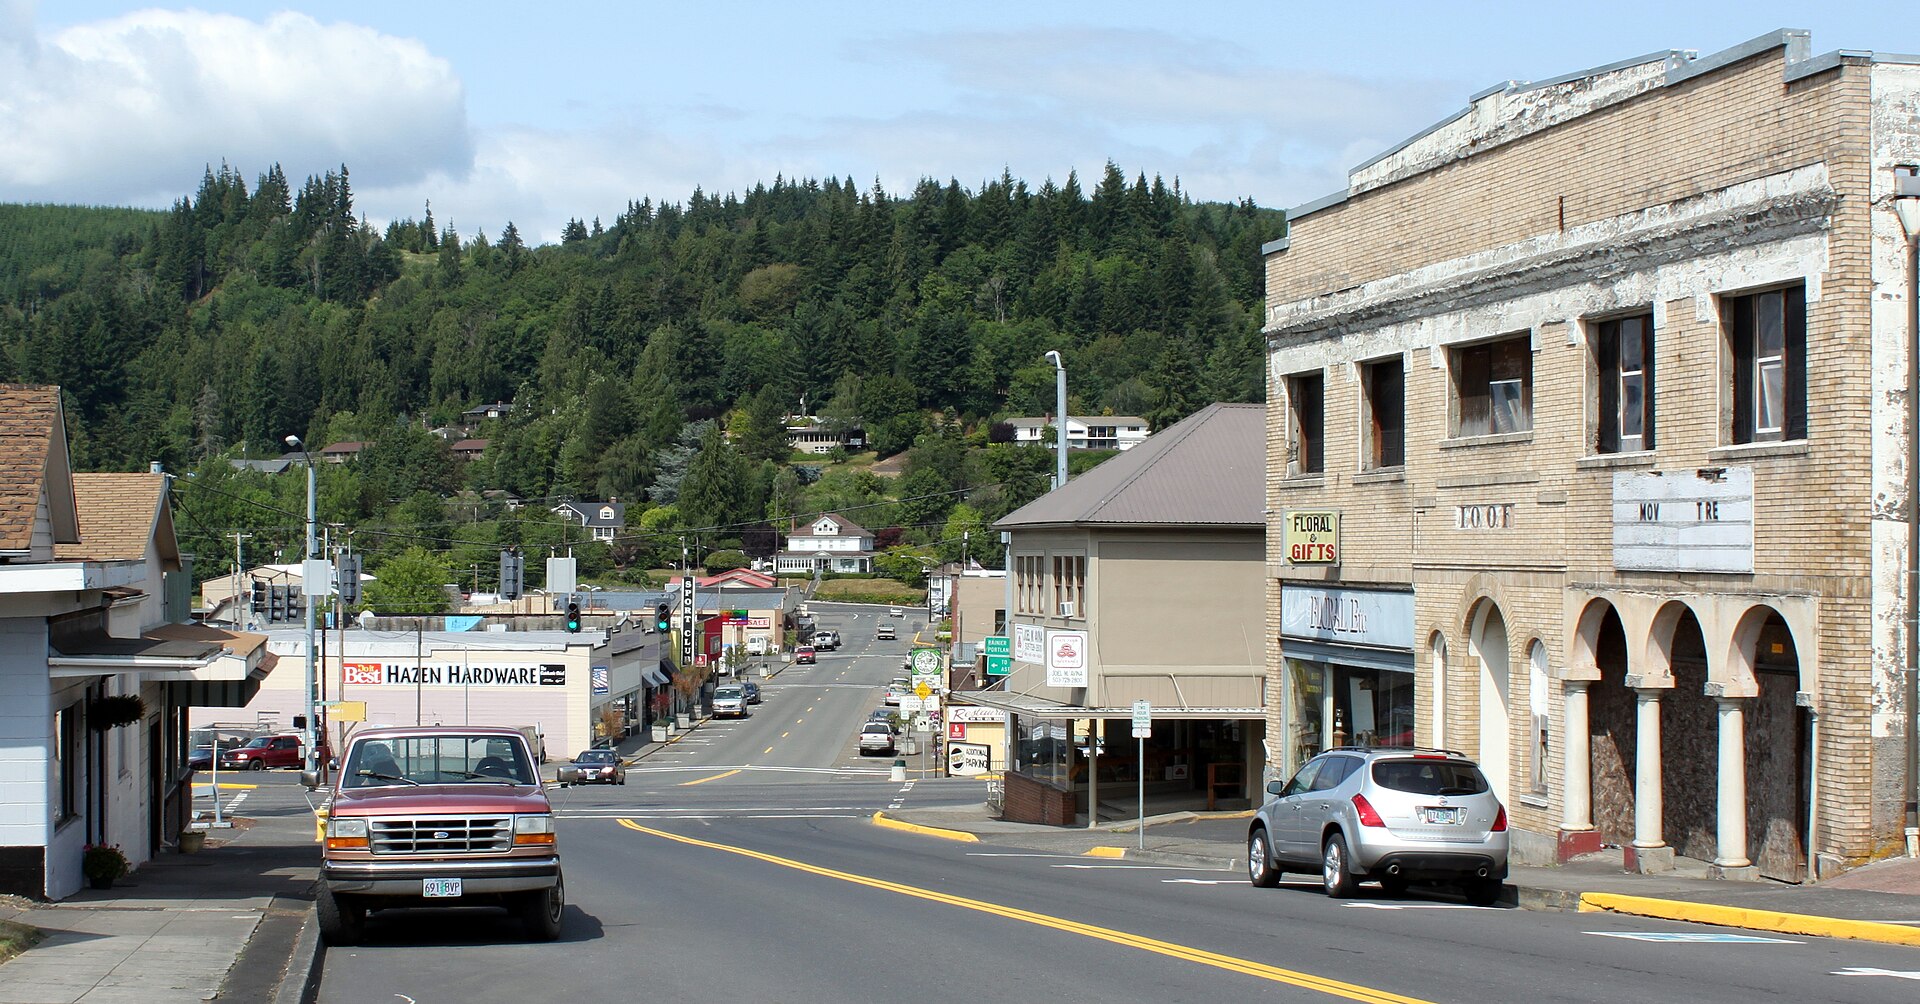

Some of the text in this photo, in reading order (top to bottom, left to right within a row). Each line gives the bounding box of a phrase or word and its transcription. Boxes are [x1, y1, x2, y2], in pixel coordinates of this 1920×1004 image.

[1640, 502, 1659, 520] MOV
[1293, 516, 1332, 532] FLORAL
[1309, 533, 1317, 542] &
[1291, 543, 1335, 560] GIFTS
[684, 580, 692, 623] SPORT
[1310, 596, 1348, 635] FLORAL
[343, 665, 537, 684] Best HAZEN HARDWARE
[425, 882, 439, 893] 691
